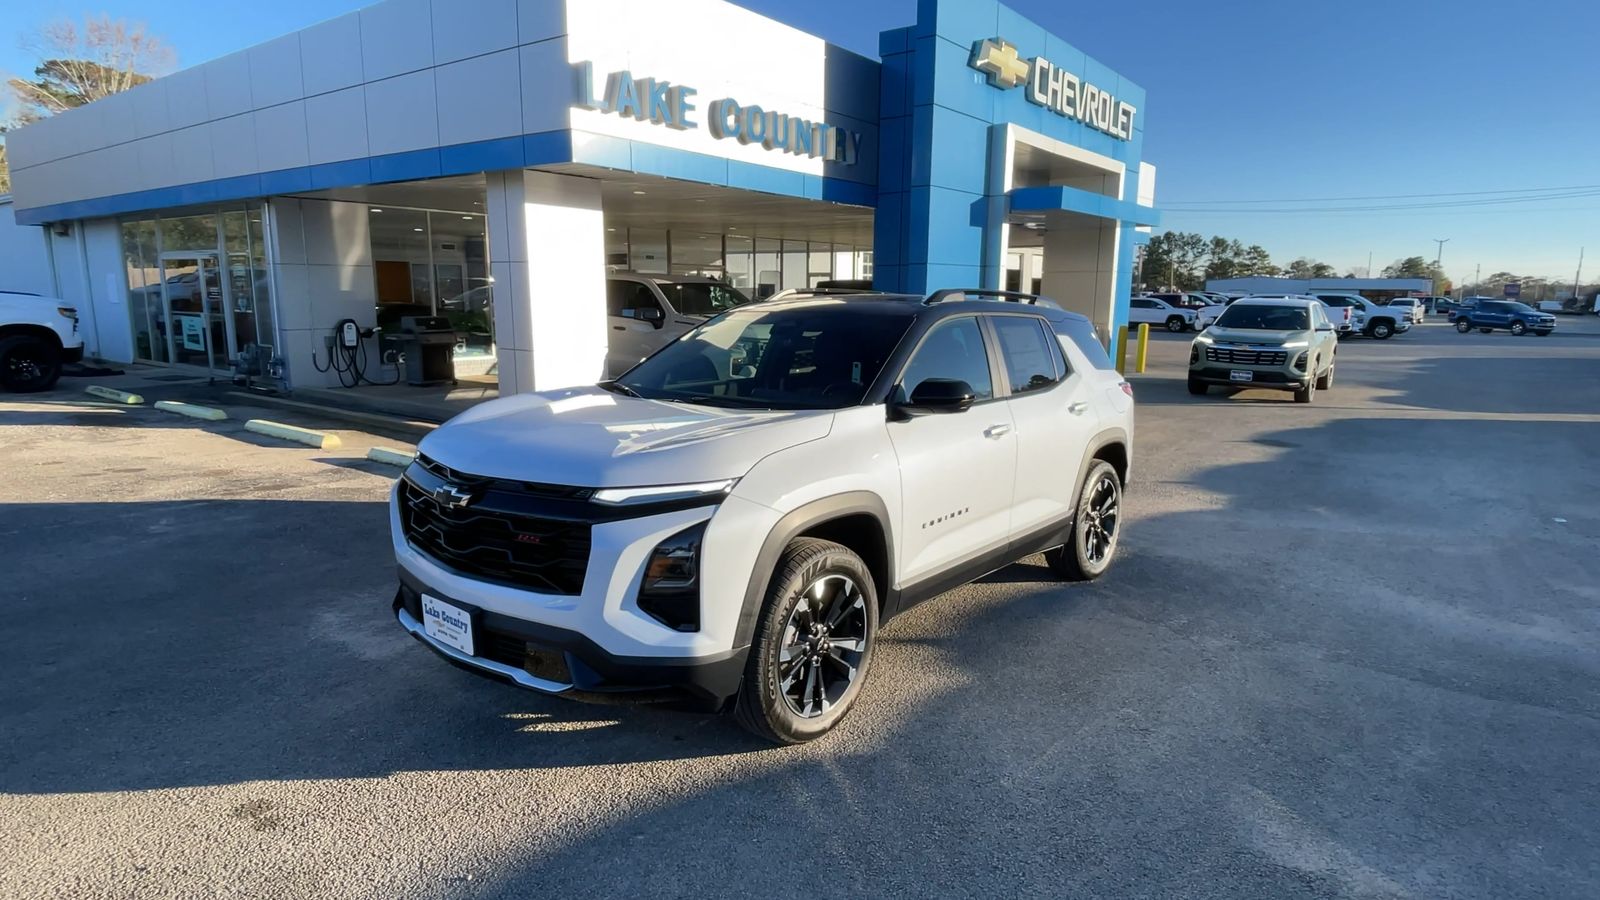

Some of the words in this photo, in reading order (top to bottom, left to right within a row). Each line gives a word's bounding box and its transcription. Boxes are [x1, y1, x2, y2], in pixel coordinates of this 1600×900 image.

[572, 60, 698, 131] LAKE
[708, 97, 863, 165] COUNTRY
[1030, 56, 1137, 141] CHEVROLET
[424, 603, 440, 620] Lake
[441, 610, 468, 634] Country
